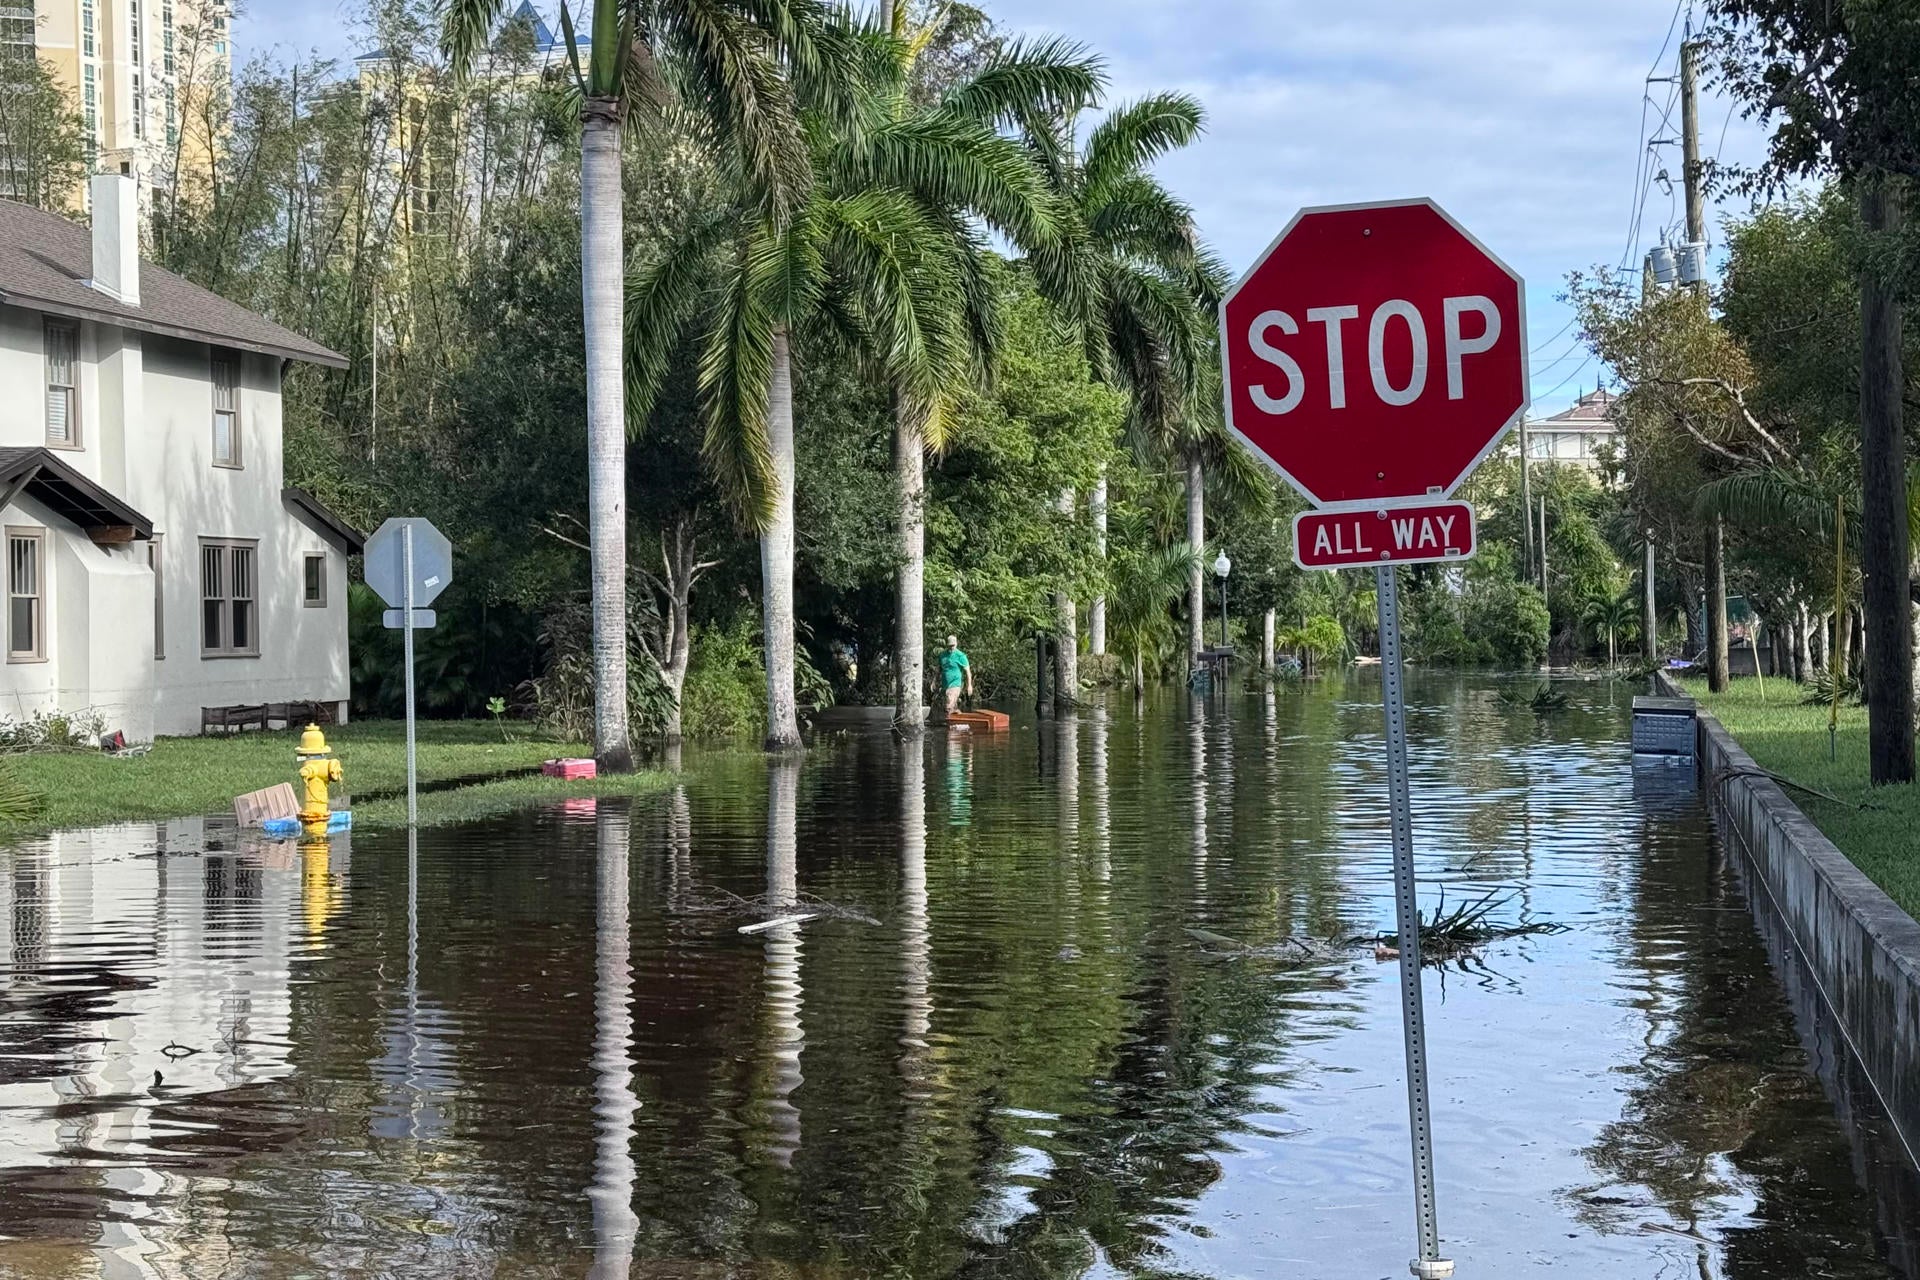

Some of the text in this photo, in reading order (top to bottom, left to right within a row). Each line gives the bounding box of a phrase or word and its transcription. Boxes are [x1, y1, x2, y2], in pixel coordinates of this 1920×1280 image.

[1248, 295, 1501, 415] STOP
[1313, 515, 1456, 556] ALL WAY
